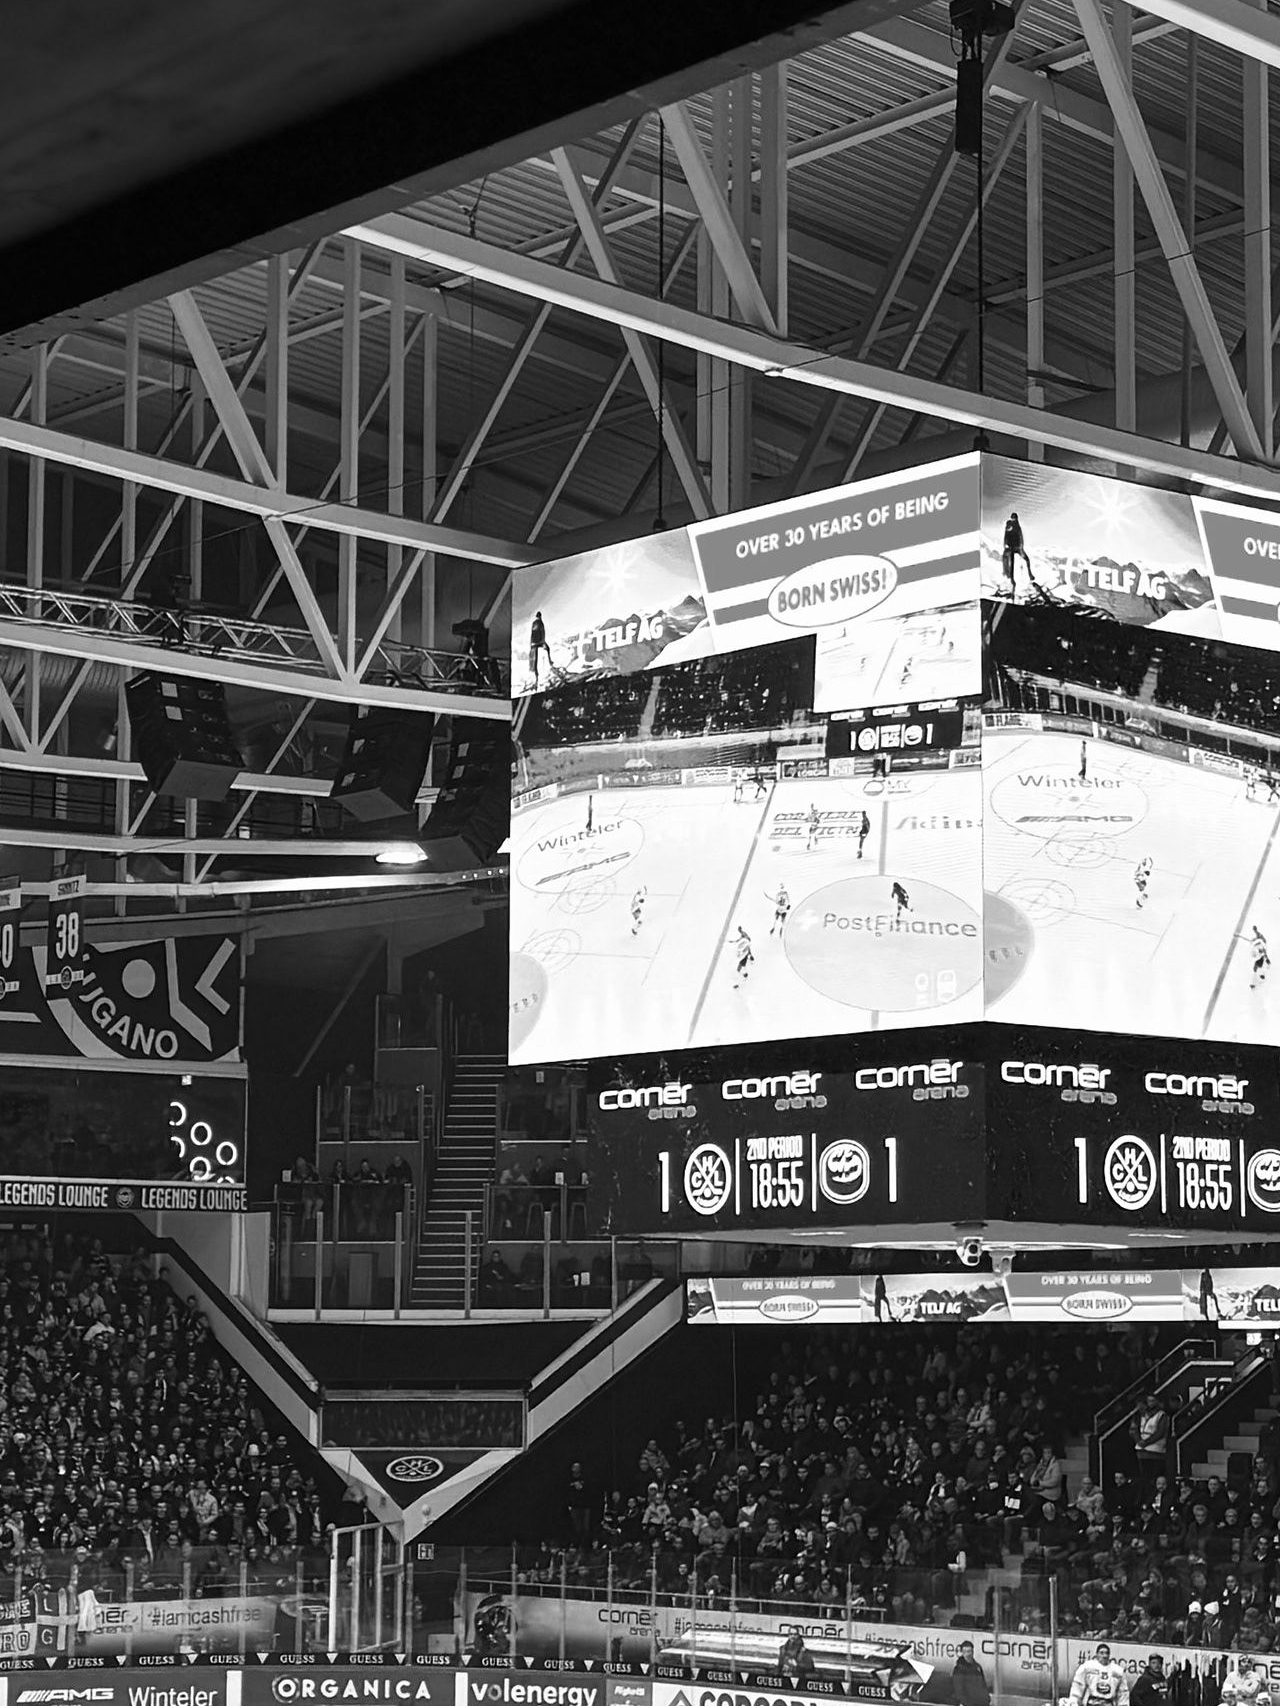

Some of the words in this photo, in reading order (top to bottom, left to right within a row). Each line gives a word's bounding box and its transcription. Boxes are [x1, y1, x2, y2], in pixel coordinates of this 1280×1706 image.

[736, 534, 779, 558] OVER
[785, 526, 804, 547] 30
[808, 513, 862, 541] YEARS
[867, 505, 890, 528] OF
[895, 492, 949, 521] BEING
[778, 583, 825, 613] BORN
[830, 568, 887, 602] SWISS!
[1086, 565, 1135, 593] TELF
[1135, 575, 1165, 600] AG
[594, 623, 637, 652] TELF
[637, 617, 663, 643] AG
[56, 912, 79, 959] 38
[823, 912, 978, 938] PostFinance
[775, 1095, 827, 1111] arena
[913, 1083, 969, 1101] arena
[1061, 1089, 1117, 1105] arena
[648, 1106, 697, 1120] arena
[1201, 1099, 1255, 1114] arena
[747, 1137, 767, 1161] 2ND
[768, 1135, 803, 1159] PERIOD
[1173, 1136, 1194, 1160] 2ND
[1194, 1138, 1230, 1161] PERIOD
[659, 1151, 669, 1212] 1
[885, 1137, 897, 1202] 1
[1075, 1137, 1087, 1203] 1
[59, 1185, 108, 1207] LOUNGE
[750, 1161, 803, 1209] 18:55
[1177, 1162, 1232, 1211] 18:55
[141, 1187, 196, 1209] LEGENDS
[200, 1189, 247, 1211] LOUNGE
[139, 1654, 175, 1665] GUESS
[417, 1654, 450, 1665] GUESS
[277, 1679, 431, 1699] ORGANICA
